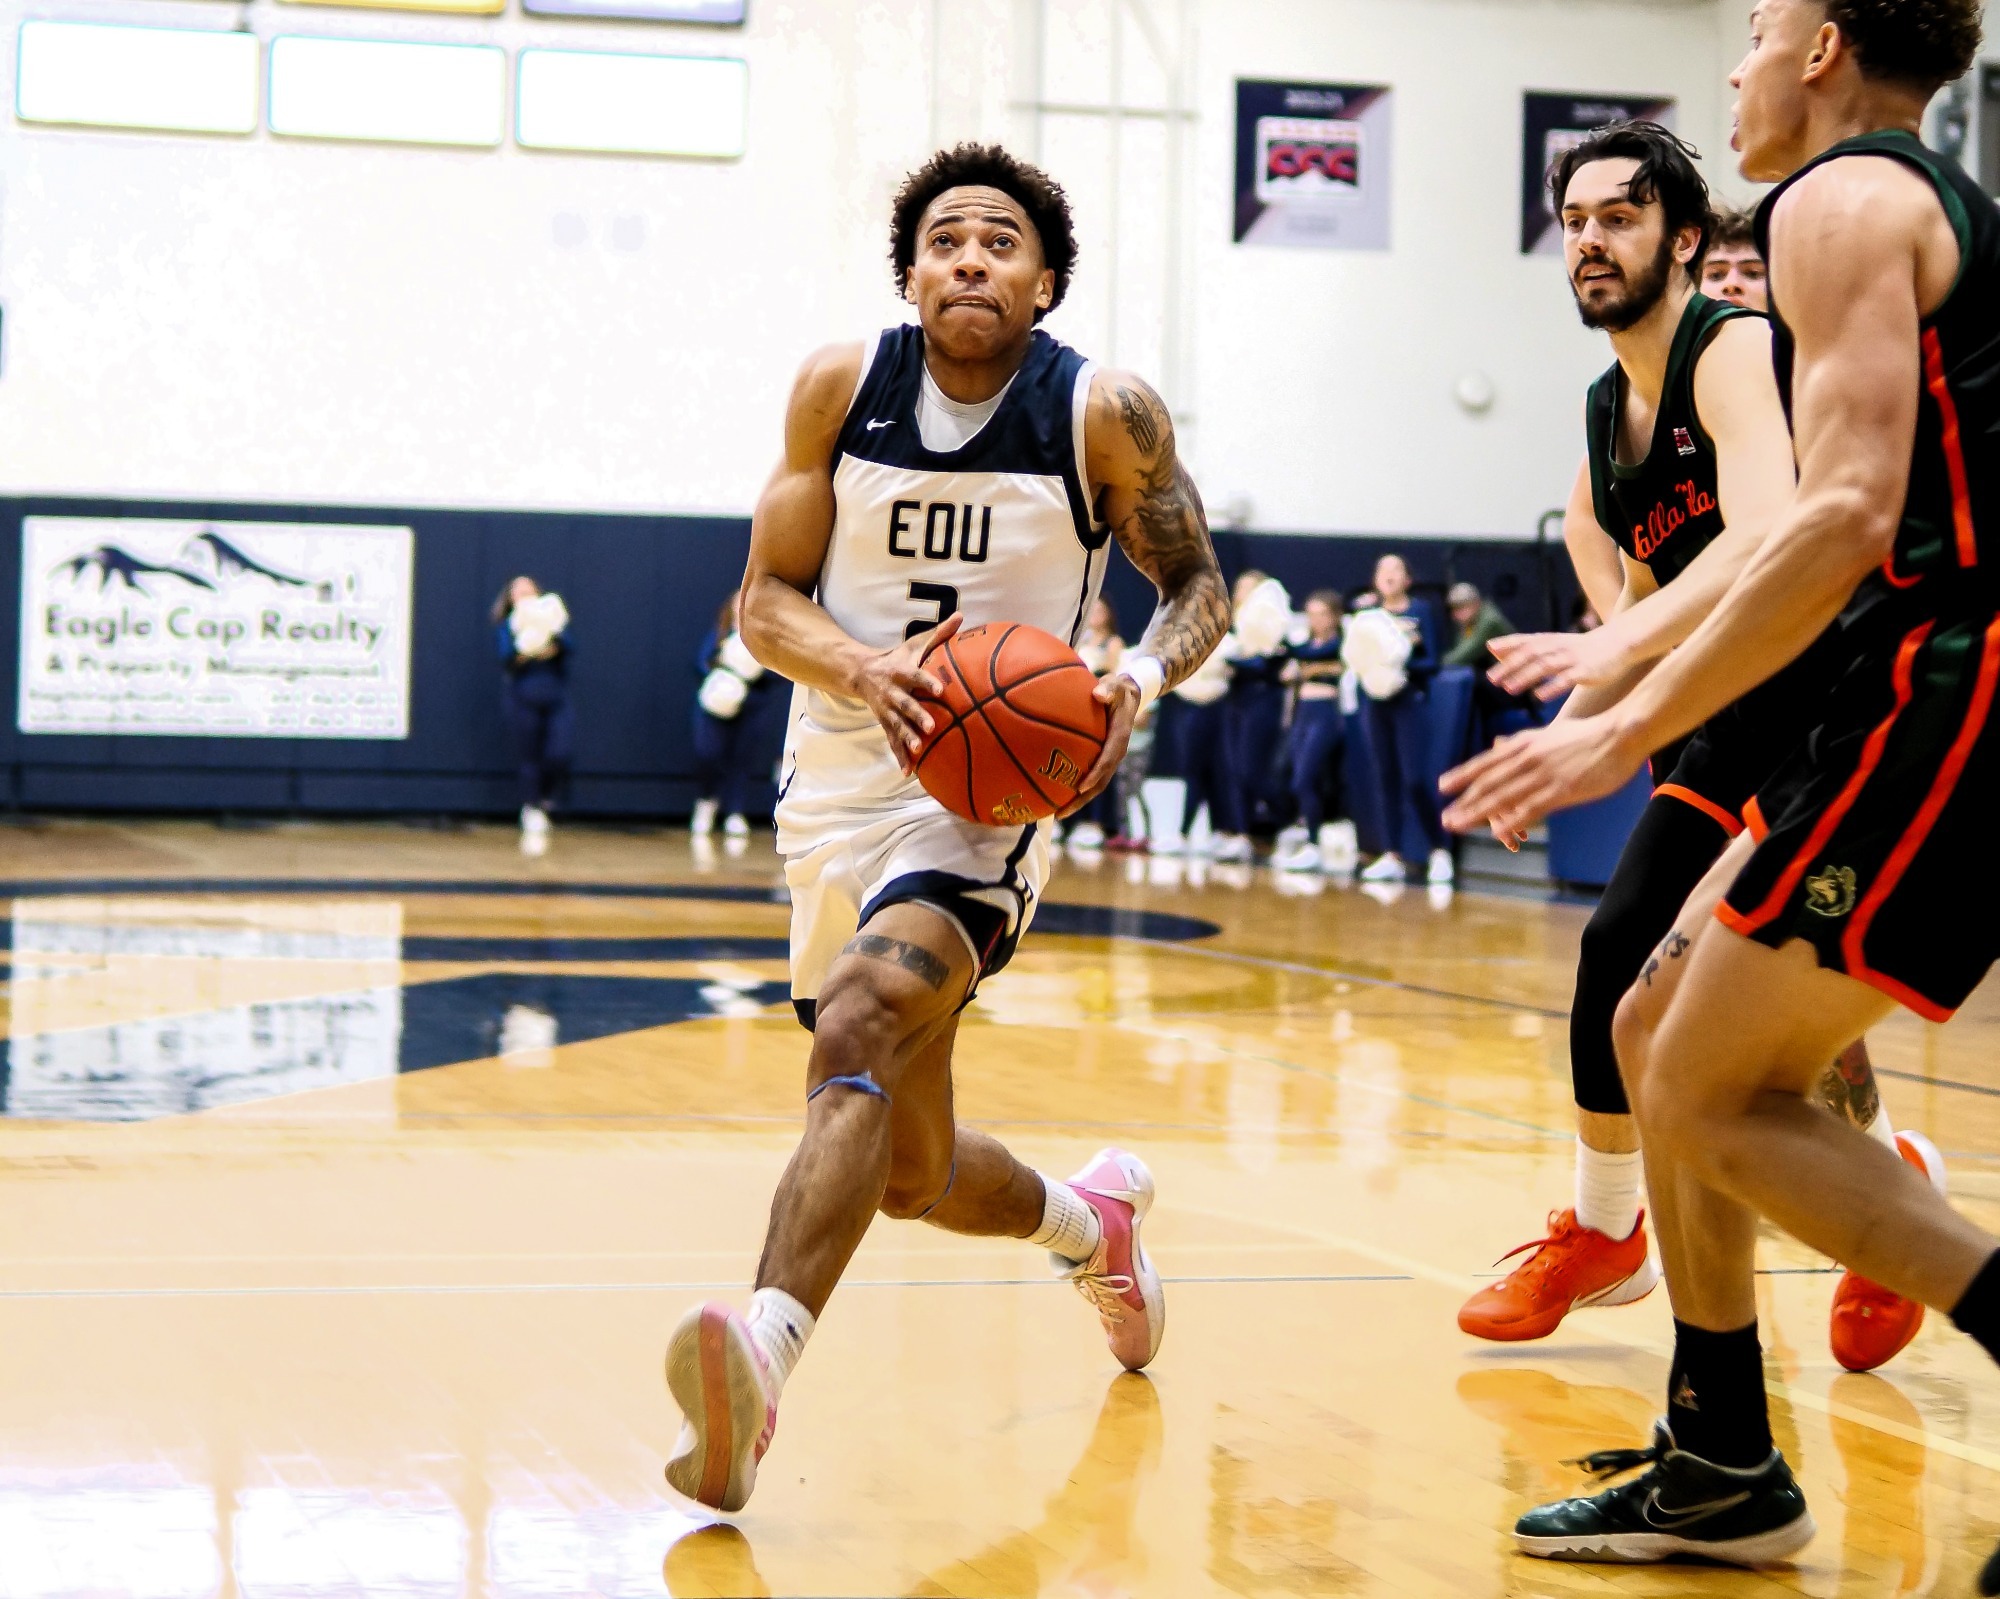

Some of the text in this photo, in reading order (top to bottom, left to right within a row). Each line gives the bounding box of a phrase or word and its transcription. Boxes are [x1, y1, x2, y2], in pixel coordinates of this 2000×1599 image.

[888, 500, 993, 563] EOU
[45, 603, 383, 650] Eagle Cap Realty
[904, 579, 960, 641] 2
